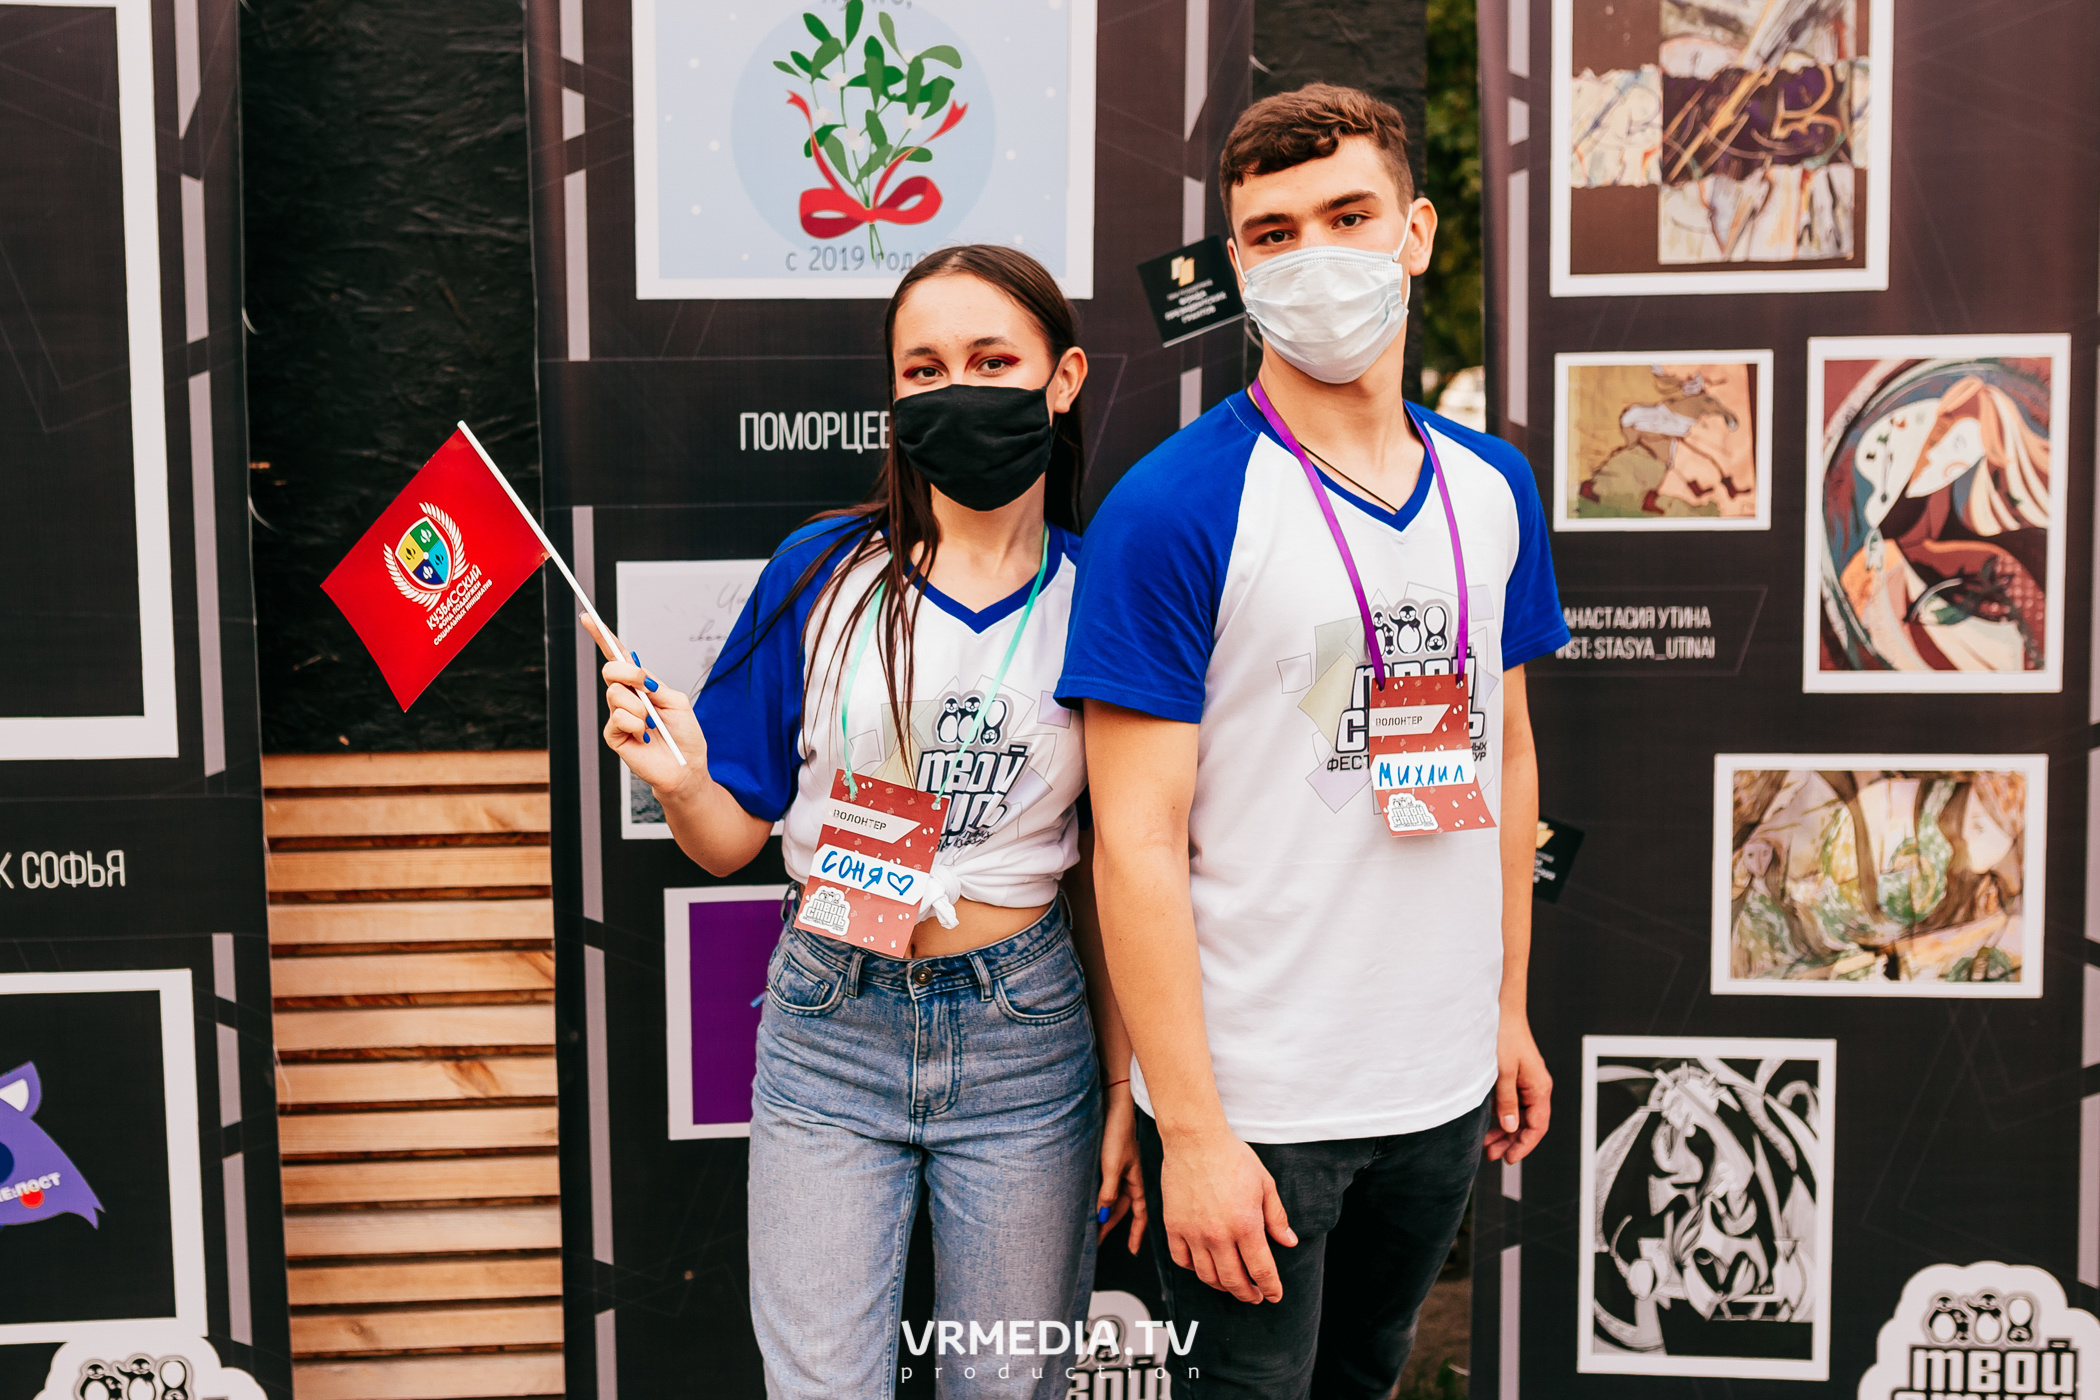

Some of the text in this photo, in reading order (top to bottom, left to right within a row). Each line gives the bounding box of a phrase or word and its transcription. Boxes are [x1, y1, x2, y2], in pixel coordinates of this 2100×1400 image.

[808, 245, 865, 271] 2019
[426, 564, 482, 630] КУЗБАССКИЙ
[438, 580, 482, 629] ФОНД ПОДДЕРЖКИ
[433, 608, 467, 646] СОЦИАЛЬНЫХ
[1563, 606, 1712, 630] АНАСТАСИЯ УТИНА
[1379, 762, 1465, 787] МИХАИЛ
[21, 849, 126, 889] СОФЬЯ
[821, 850, 883, 889] СОНЯ
